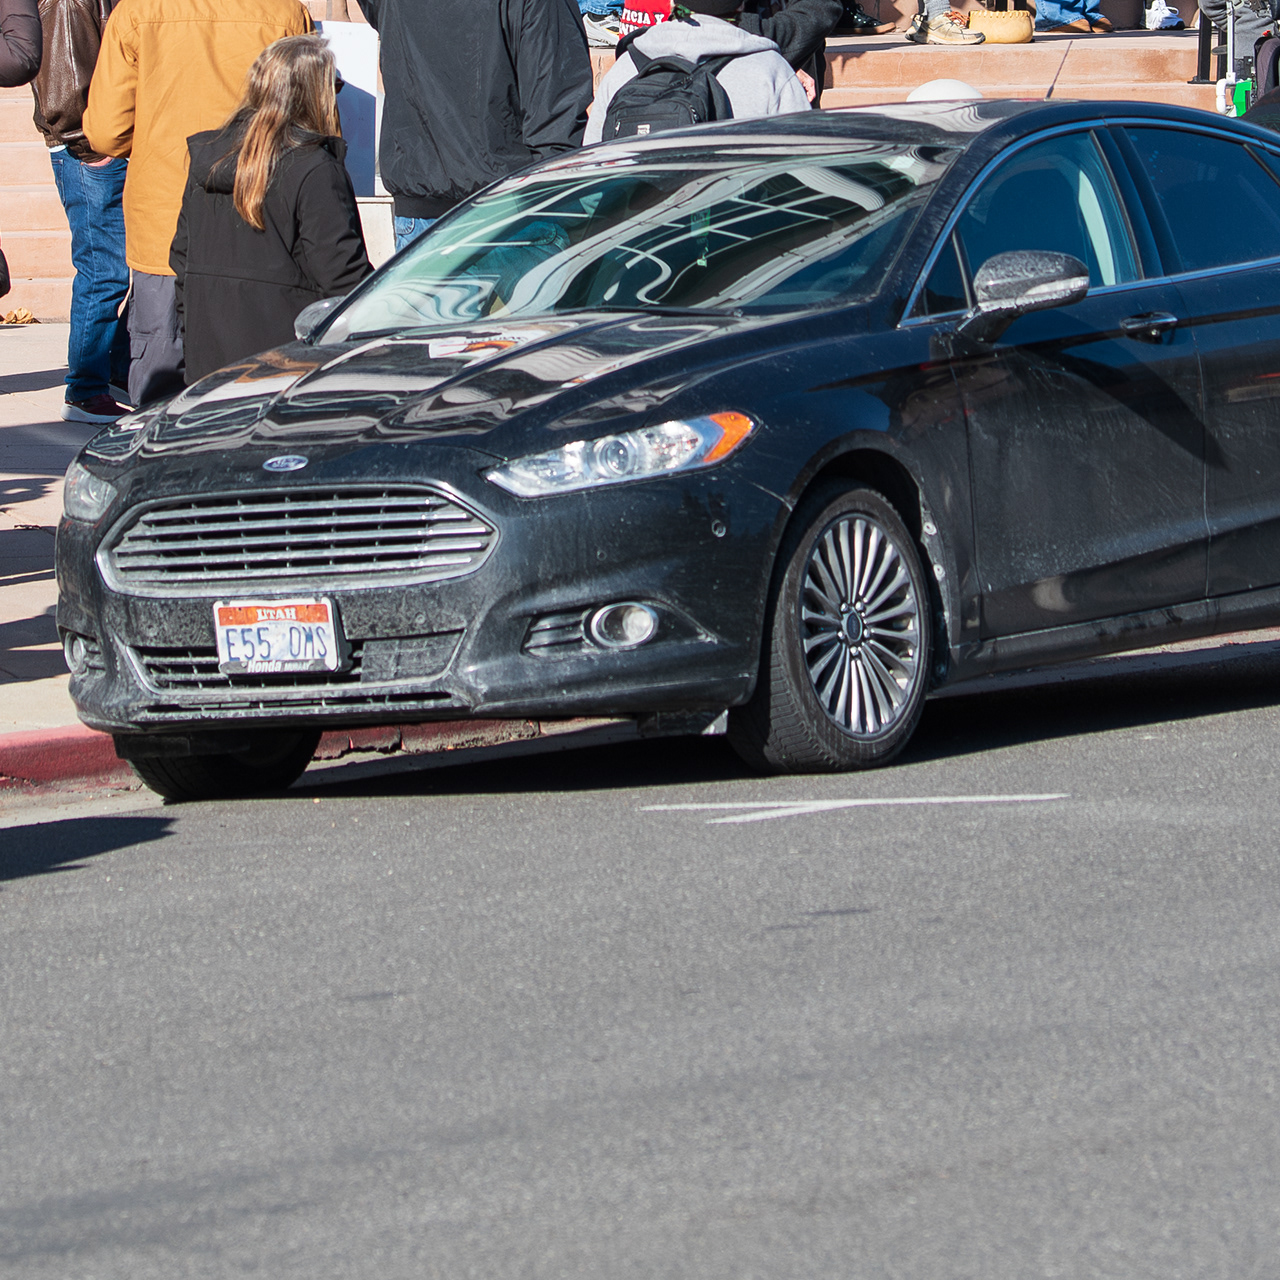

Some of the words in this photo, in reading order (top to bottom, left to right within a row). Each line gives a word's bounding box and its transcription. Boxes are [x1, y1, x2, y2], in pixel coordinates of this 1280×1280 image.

[256, 608, 296, 620] UTAH
[226, 627, 271, 661] E55
[248, 660, 281, 673] Honda
